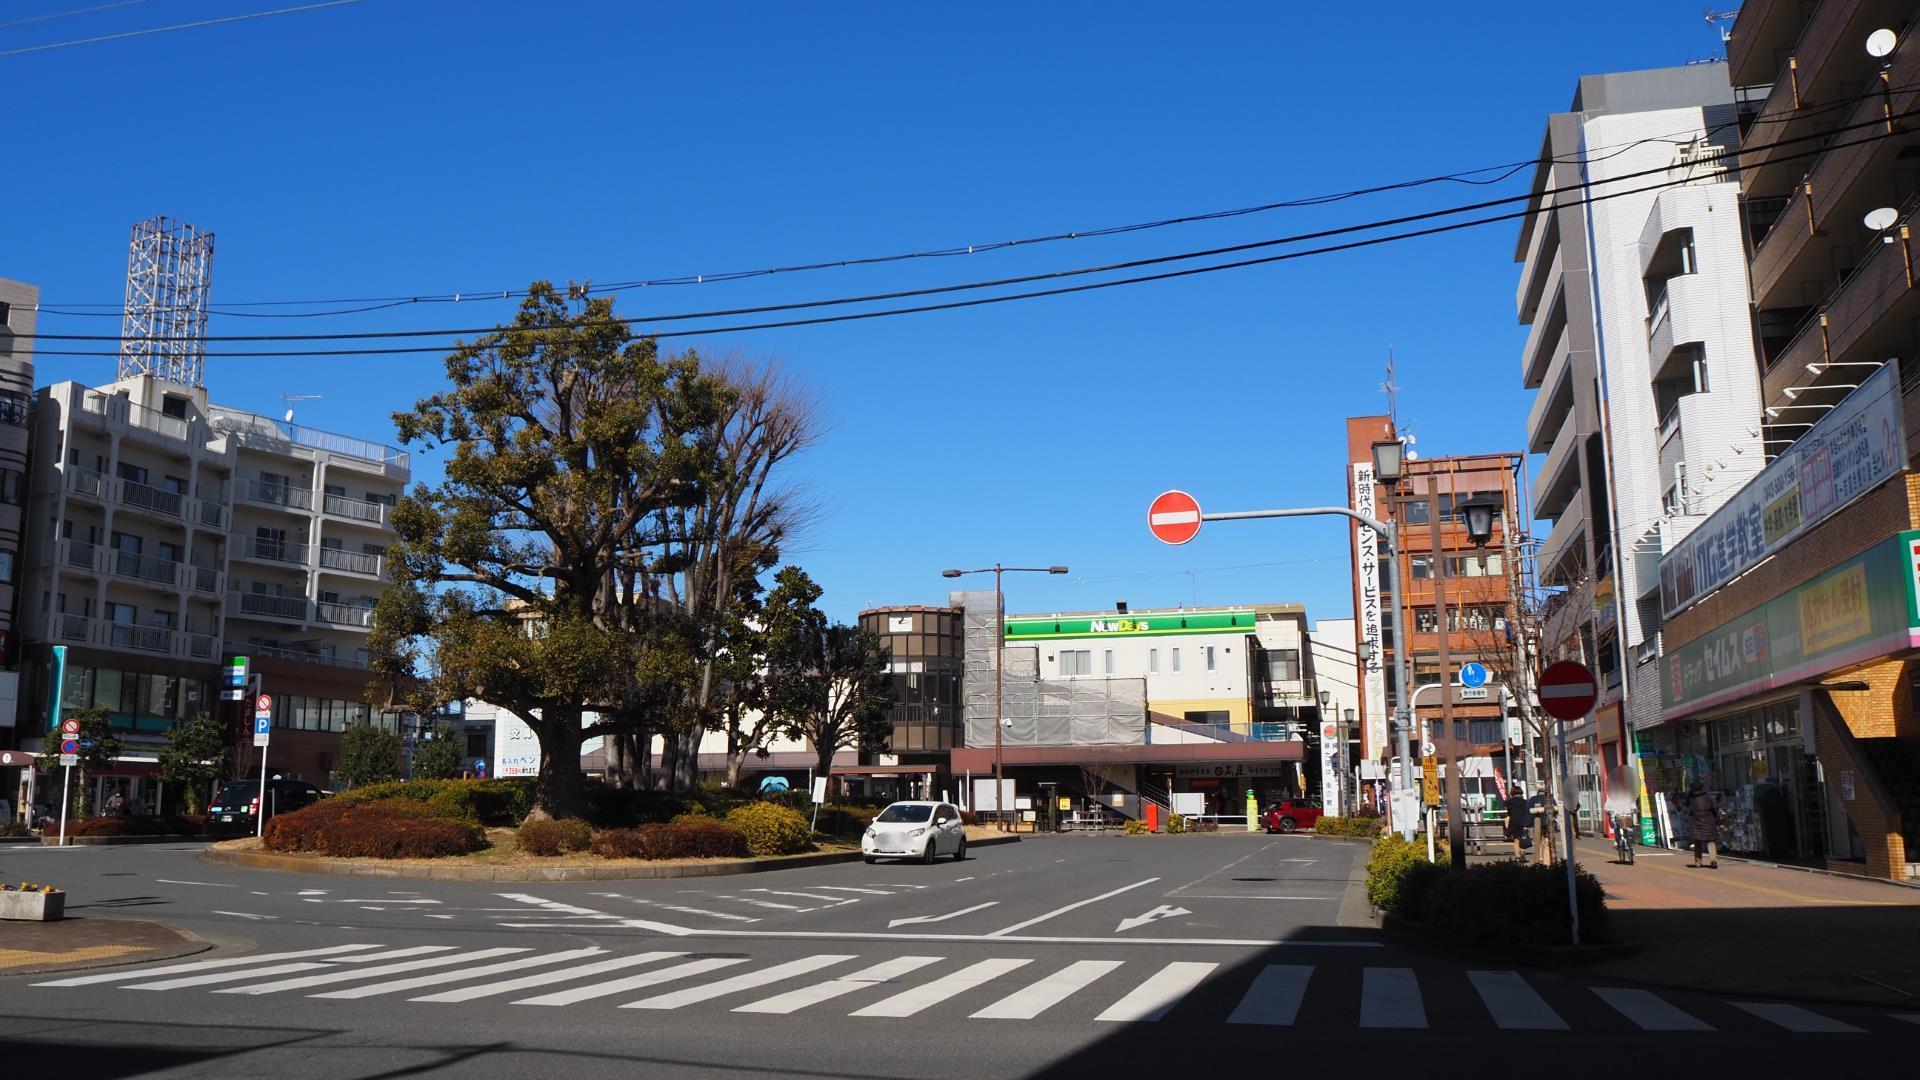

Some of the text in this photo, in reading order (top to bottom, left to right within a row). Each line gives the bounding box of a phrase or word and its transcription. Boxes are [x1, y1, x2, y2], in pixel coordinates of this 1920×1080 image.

[1090, 620, 1149, 633] NewDays
[1704, 632, 1741, 682] セイムス
[259, 720, 267, 732] P
